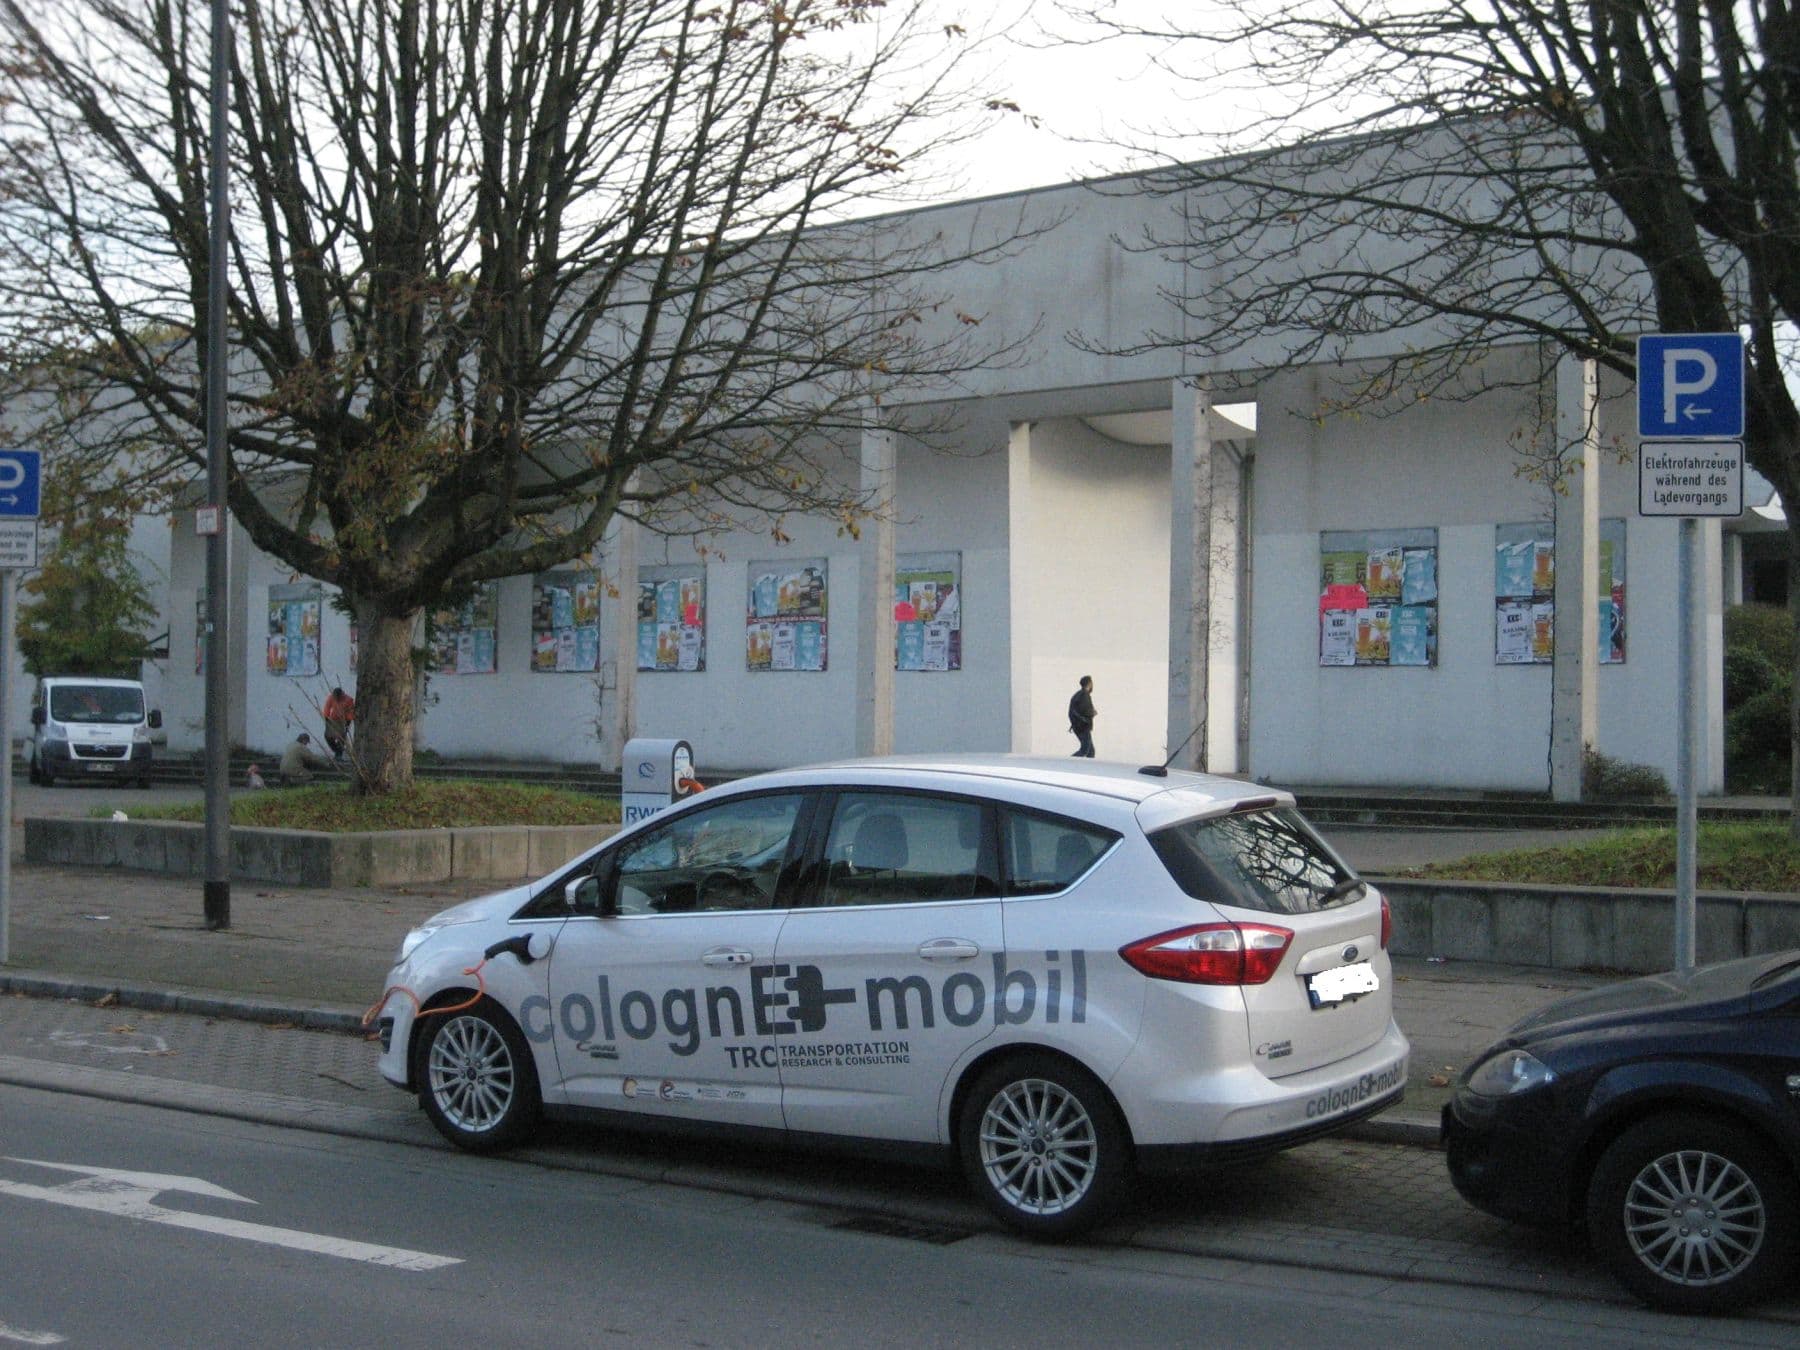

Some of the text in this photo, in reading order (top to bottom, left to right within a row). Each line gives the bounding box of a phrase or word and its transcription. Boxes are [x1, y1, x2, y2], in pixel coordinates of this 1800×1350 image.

[1663, 348, 1718, 424] P
[1645, 457, 1737, 471] Elektrofahrzeuge
[1655, 474, 1727, 486] während des
[1654, 490, 1728, 506] Ladevorgangs
[626, 806, 664, 821] RW
[780, 1041, 909, 1057] TRANSPORTATION
[725, 1046, 777, 1068] TRC
[782, 1054, 910, 1067] RESEARCH & CONSULTING
